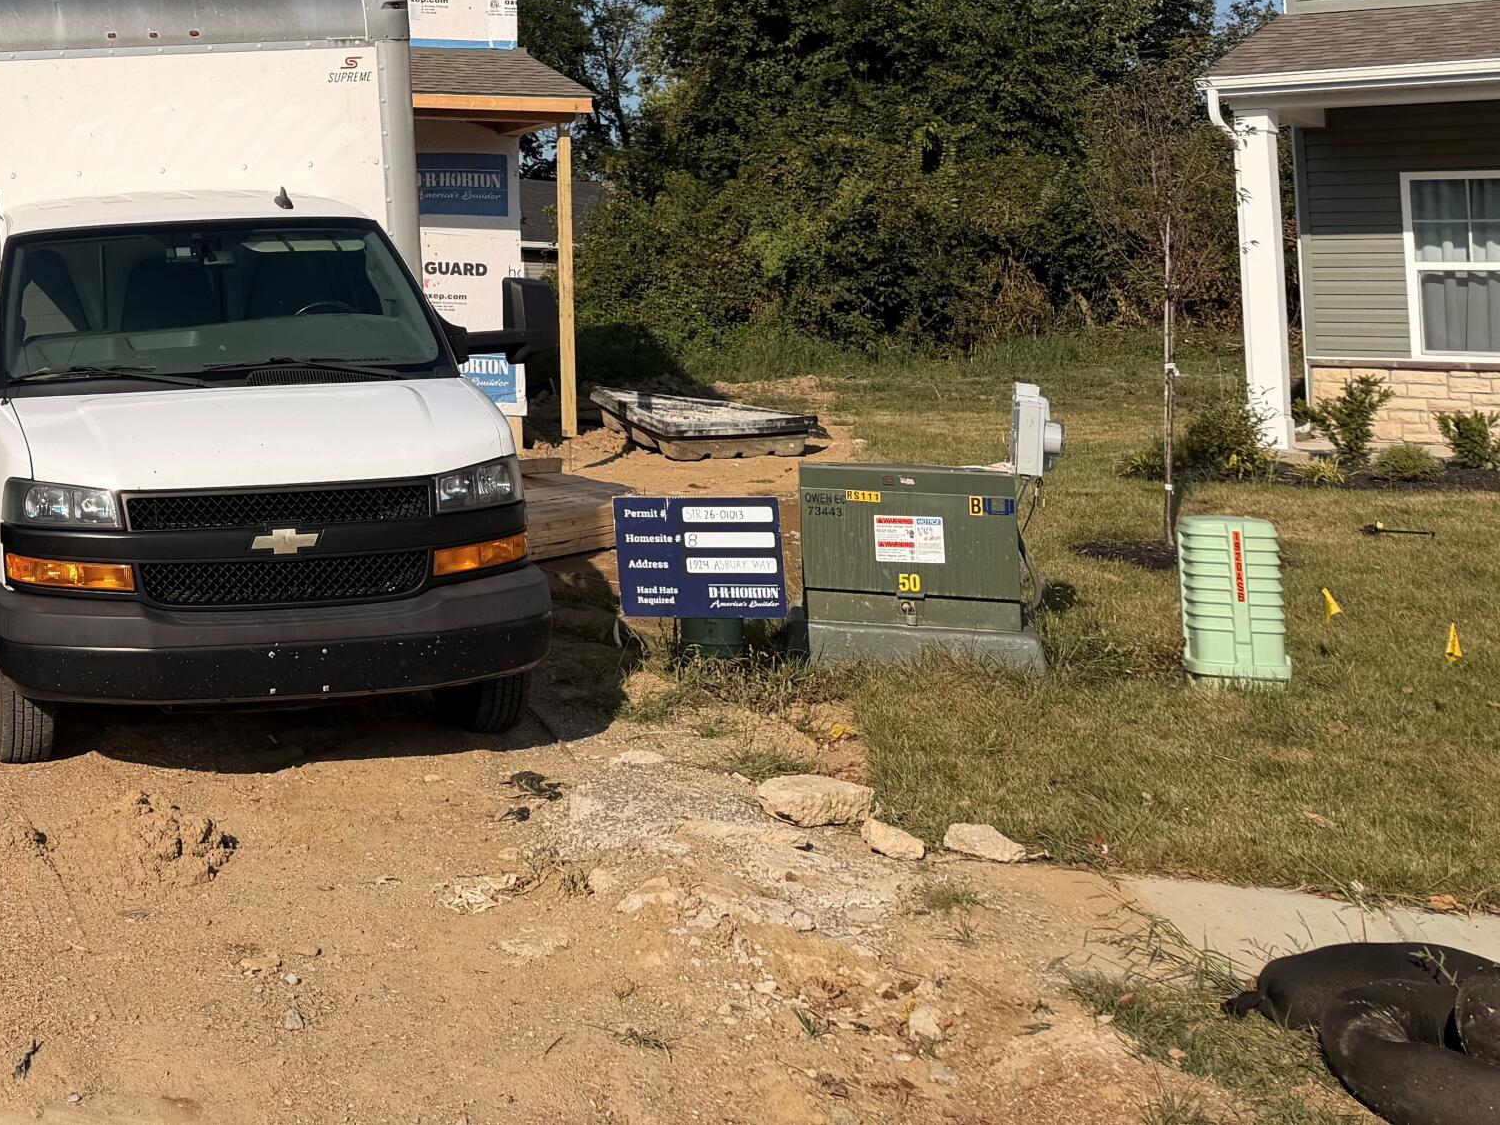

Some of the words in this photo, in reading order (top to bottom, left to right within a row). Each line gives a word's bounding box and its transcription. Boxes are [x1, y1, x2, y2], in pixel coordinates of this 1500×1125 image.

[328, 72, 372, 83] SUPREME
[424, 261, 488, 276] GUARD
[805, 492, 833, 504] OWEN
[624, 509, 658, 518] Permit
[808, 506, 843, 516] 73443
[625, 534, 673, 543] Homesite
[675, 535, 681, 543] #
[688, 533, 698, 547] 8
[628, 559, 669, 569] Address
[898, 573, 921, 592] 50
[636, 586, 658, 594] Hard
[659, 586, 679, 594] Hats
[637, 596, 675, 605] Required
